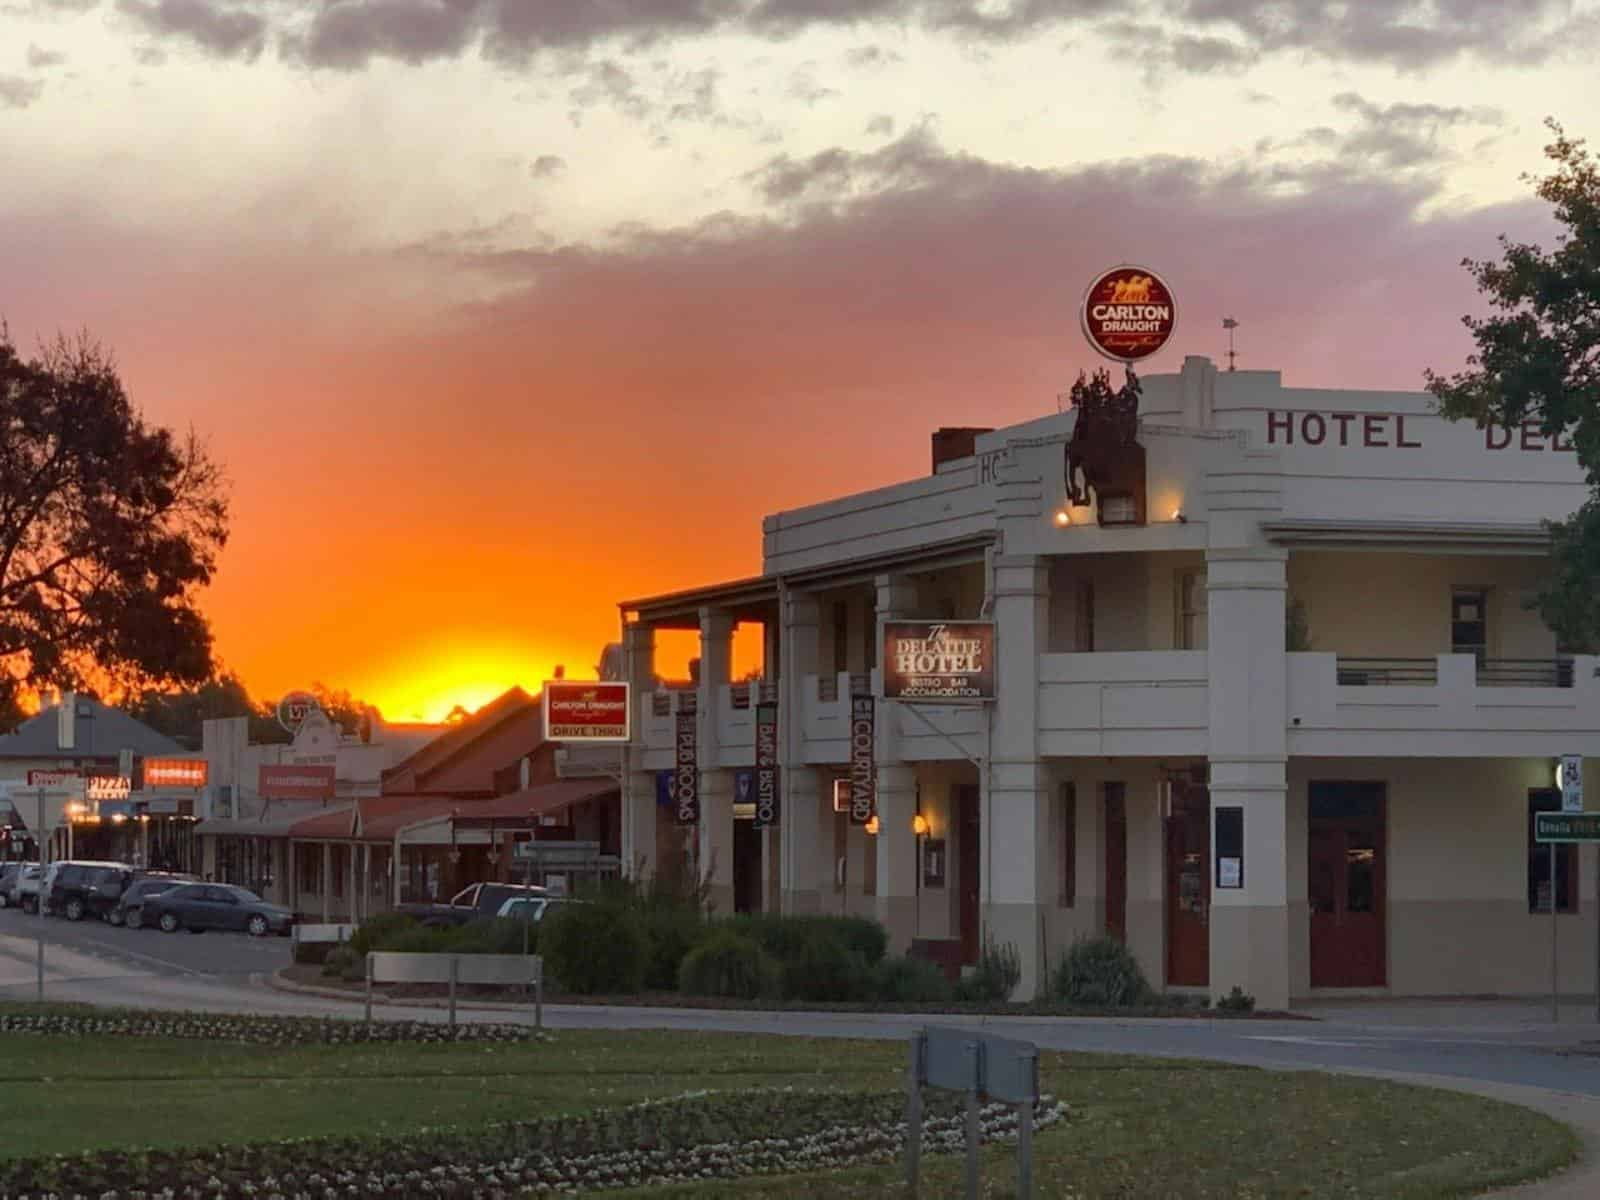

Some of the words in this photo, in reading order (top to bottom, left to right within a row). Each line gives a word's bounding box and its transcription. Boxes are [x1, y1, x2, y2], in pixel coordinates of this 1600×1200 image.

[1092, 305, 1169, 321] CARLTON
[1102, 320, 1161, 333] DRAUGHT
[1267, 411, 1422, 449] HOTEL
[927, 624, 950, 641] The
[896, 654, 983, 674] HOTEL
[553, 726, 585, 737] DRIVE
[591, 726, 623, 737] THRU
[759, 724, 774, 752] BAR
[679, 734, 694, 762] PUB
[853, 720, 872, 821] COURTYARD
[88, 776, 131, 790] PIZZA
[679, 764, 694, 820] ROOMS
[758, 769, 774, 822] BISTRO
